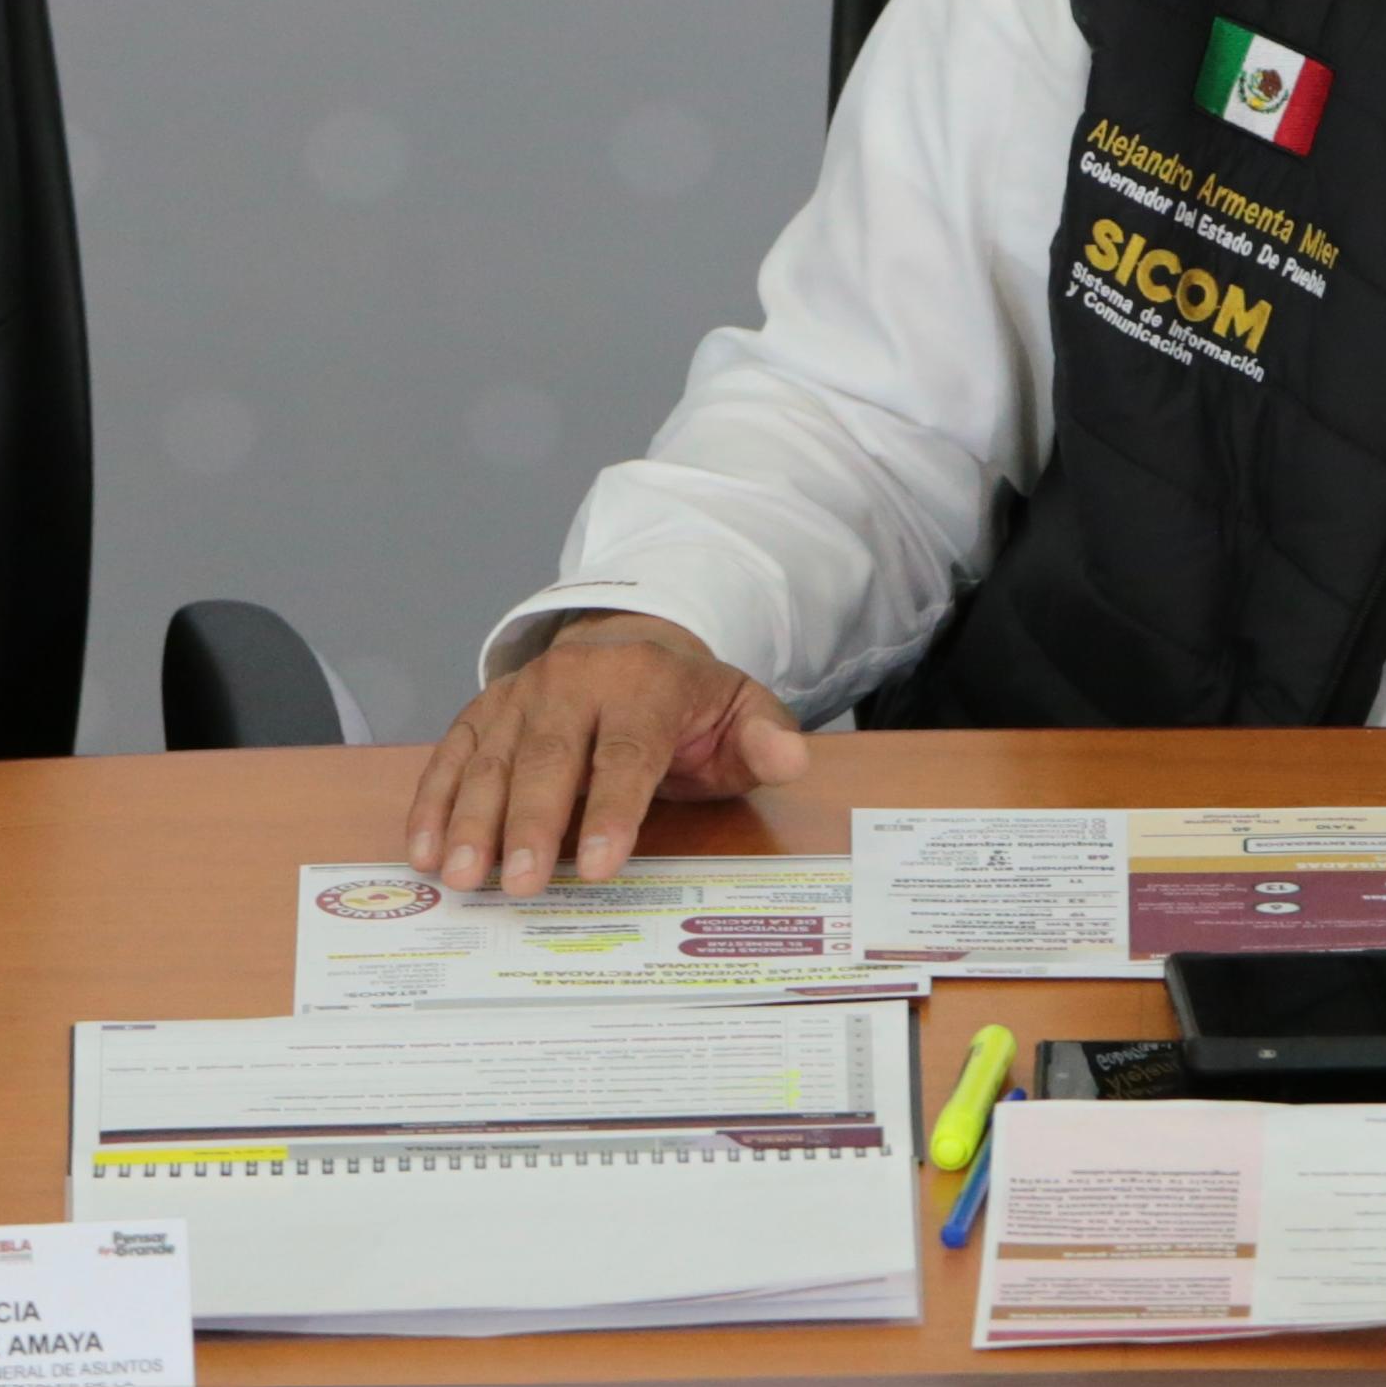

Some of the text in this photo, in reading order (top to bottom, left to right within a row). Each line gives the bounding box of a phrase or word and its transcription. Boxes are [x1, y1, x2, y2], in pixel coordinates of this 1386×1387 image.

[1080, 151, 1327, 299] Gobernador Del Estado De Puebla
[1087, 119, 1340, 269] Alejandro Armenta Mier
[1065, 280, 1193, 366] y Comunicación
[1072, 262, 1265, 383] Sistema de Información
[1084, 218, 1273, 354] SICOM
[112, 1230, 168, 1246] Pensar
[113, 1241, 176, 1257] Grande
[8, 1331, 104, 1357] AMAYA
[52, 1361, 79, 1378] DE
[80, 1358, 164, 1375] ASUNTOS
